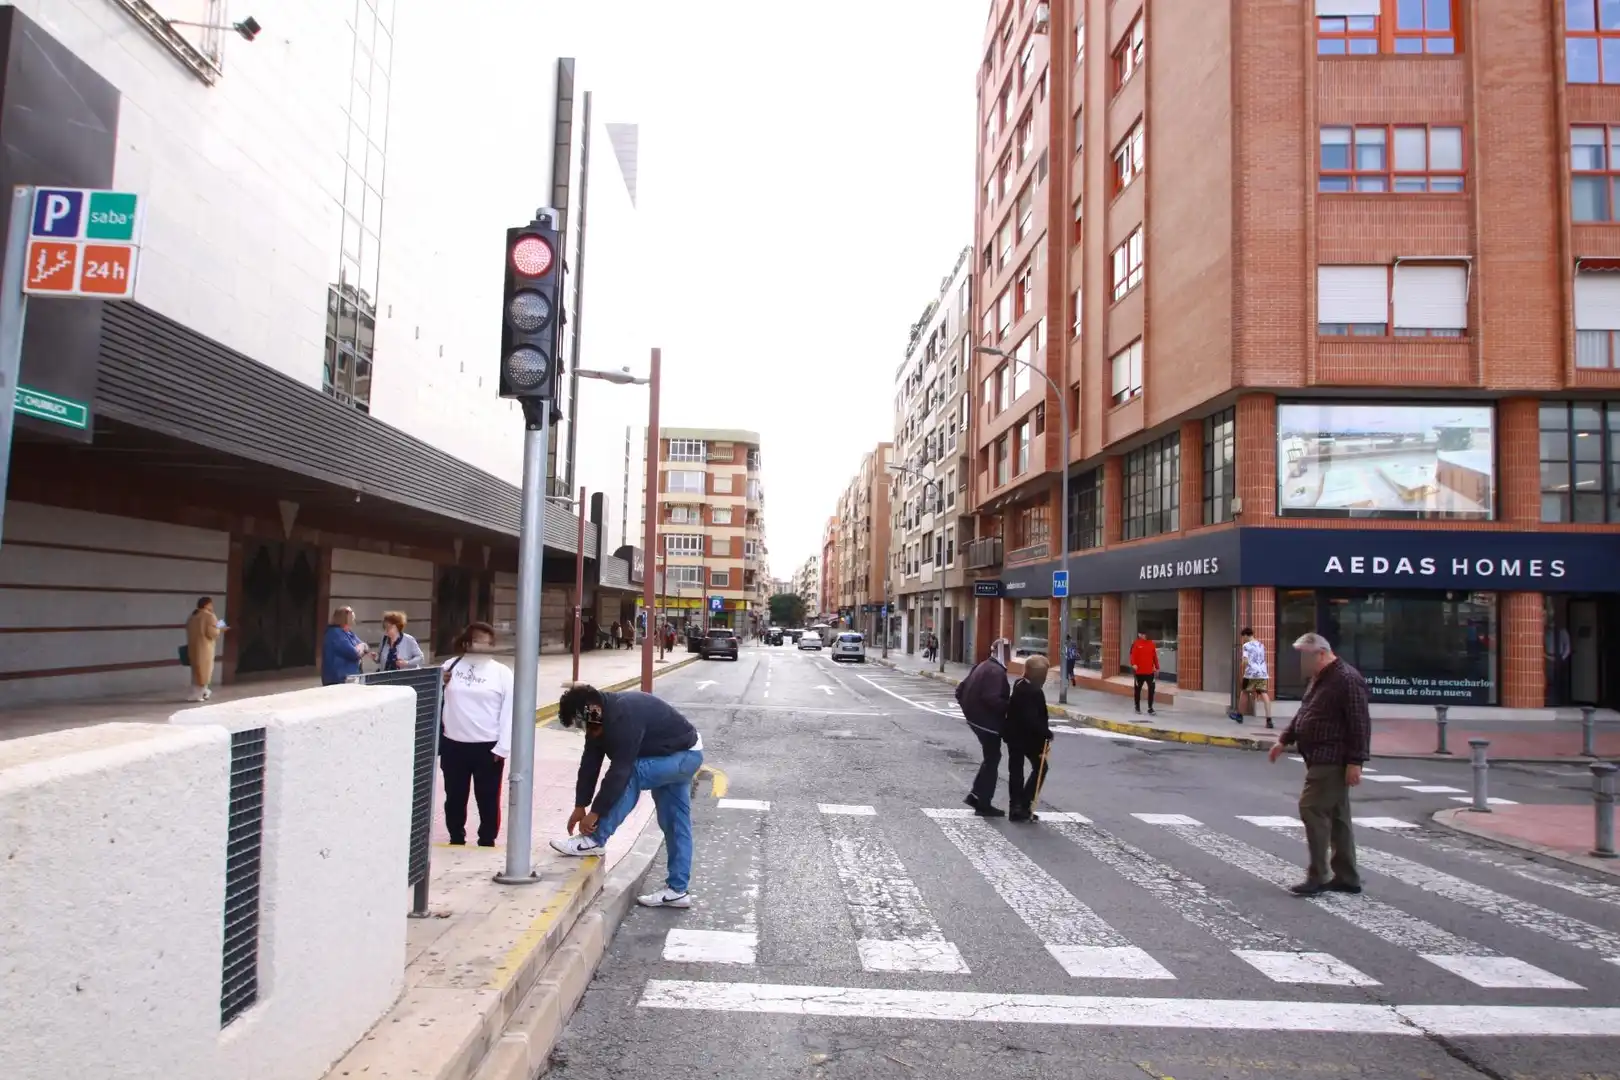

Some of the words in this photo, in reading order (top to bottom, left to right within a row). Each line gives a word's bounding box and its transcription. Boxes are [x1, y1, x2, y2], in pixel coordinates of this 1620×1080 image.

[43, 195, 71, 232] P
[91, 209, 127, 225] saba
[1139, 562, 1173, 580] AEDAS
[1176, 557, 1218, 576] HOMES
[1324, 556, 1436, 575] AEDAS
[1452, 558, 1566, 577] HOMES
[1375, 676, 1410, 685] hablan.
[1411, 677, 1429, 686] Ven
[1406, 687, 1418, 695] de
[1419, 687, 1442, 696] obra
[1443, 689, 1472, 697] nueva
